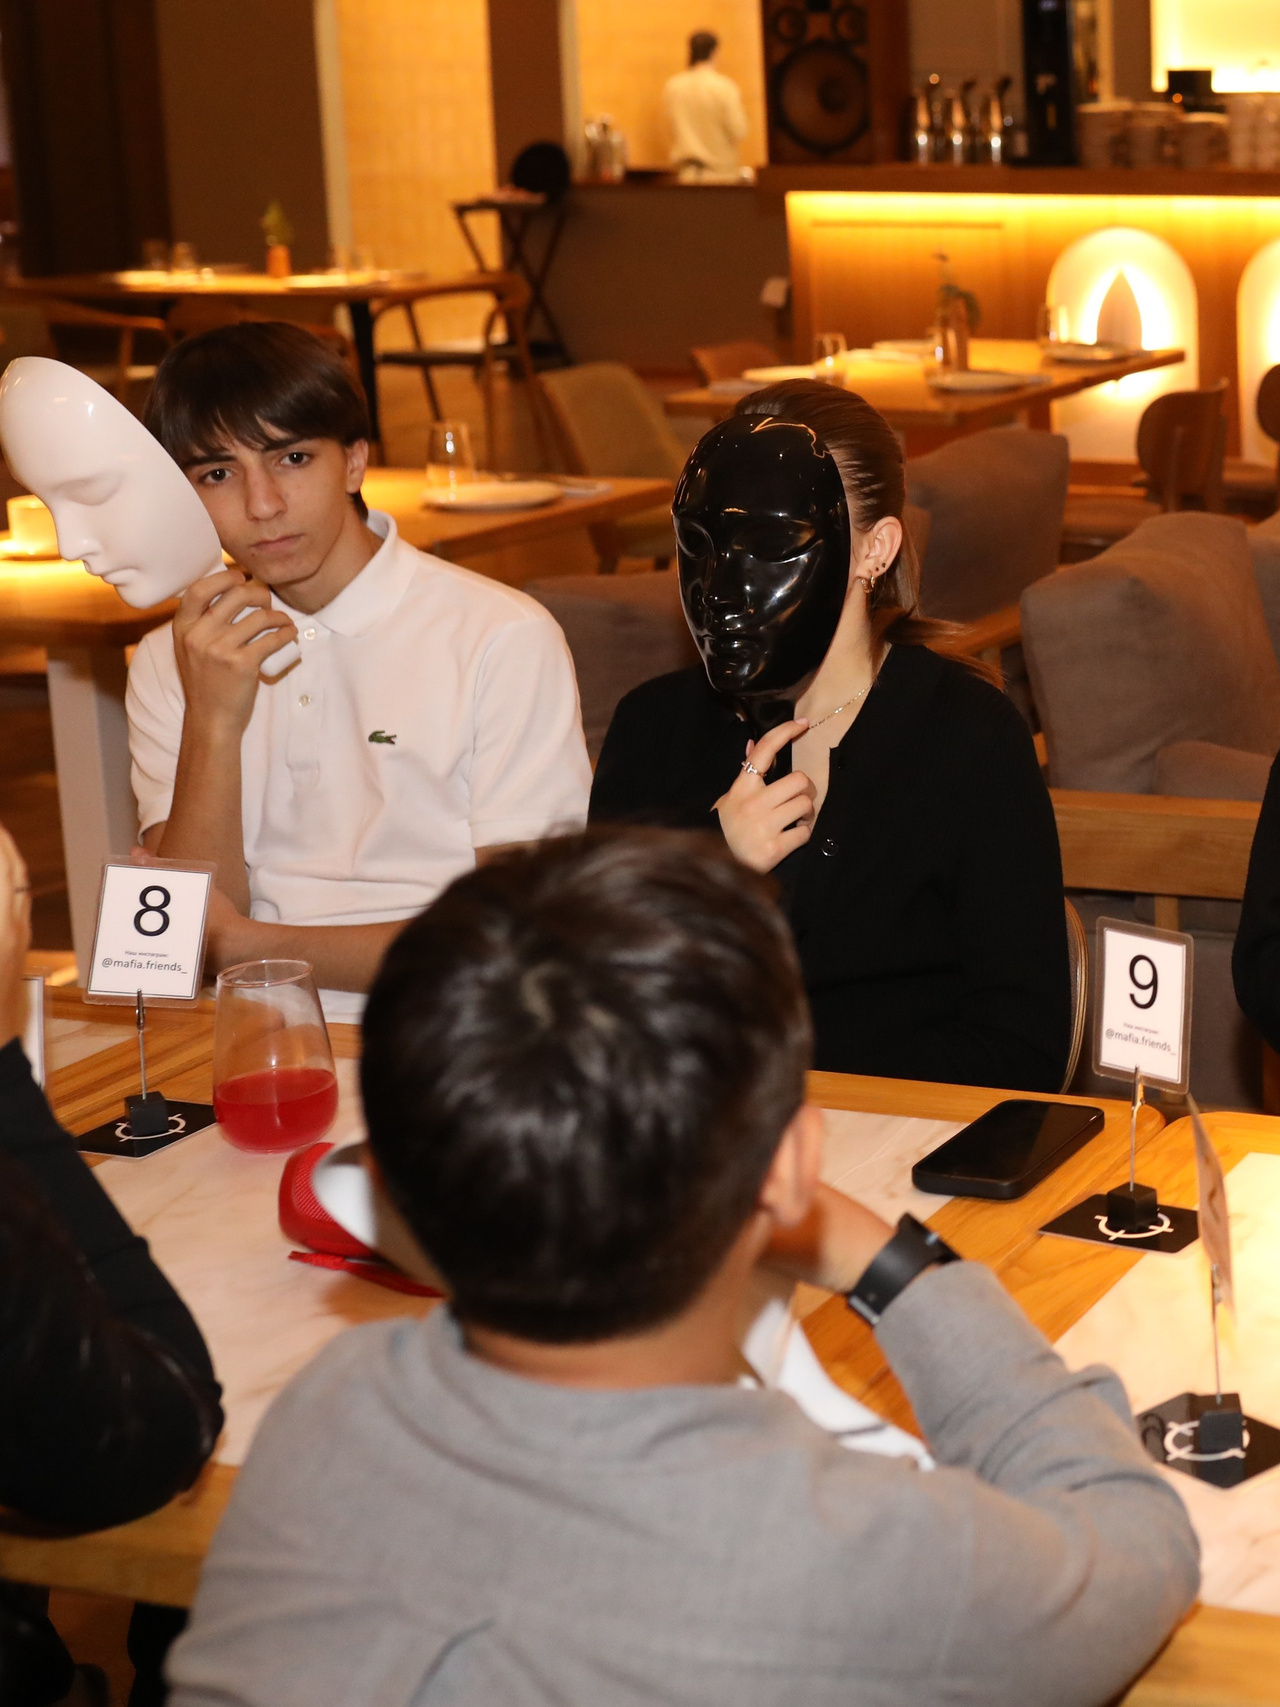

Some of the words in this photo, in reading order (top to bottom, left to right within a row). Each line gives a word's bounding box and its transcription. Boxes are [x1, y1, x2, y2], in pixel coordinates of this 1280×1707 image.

[133, 885, 171, 937] 8
[101, 957, 188, 975] @mafia.friends_
[1129, 954, 1159, 1010] 9
[1105, 1028, 1177, 1056] @mafia.friends_
